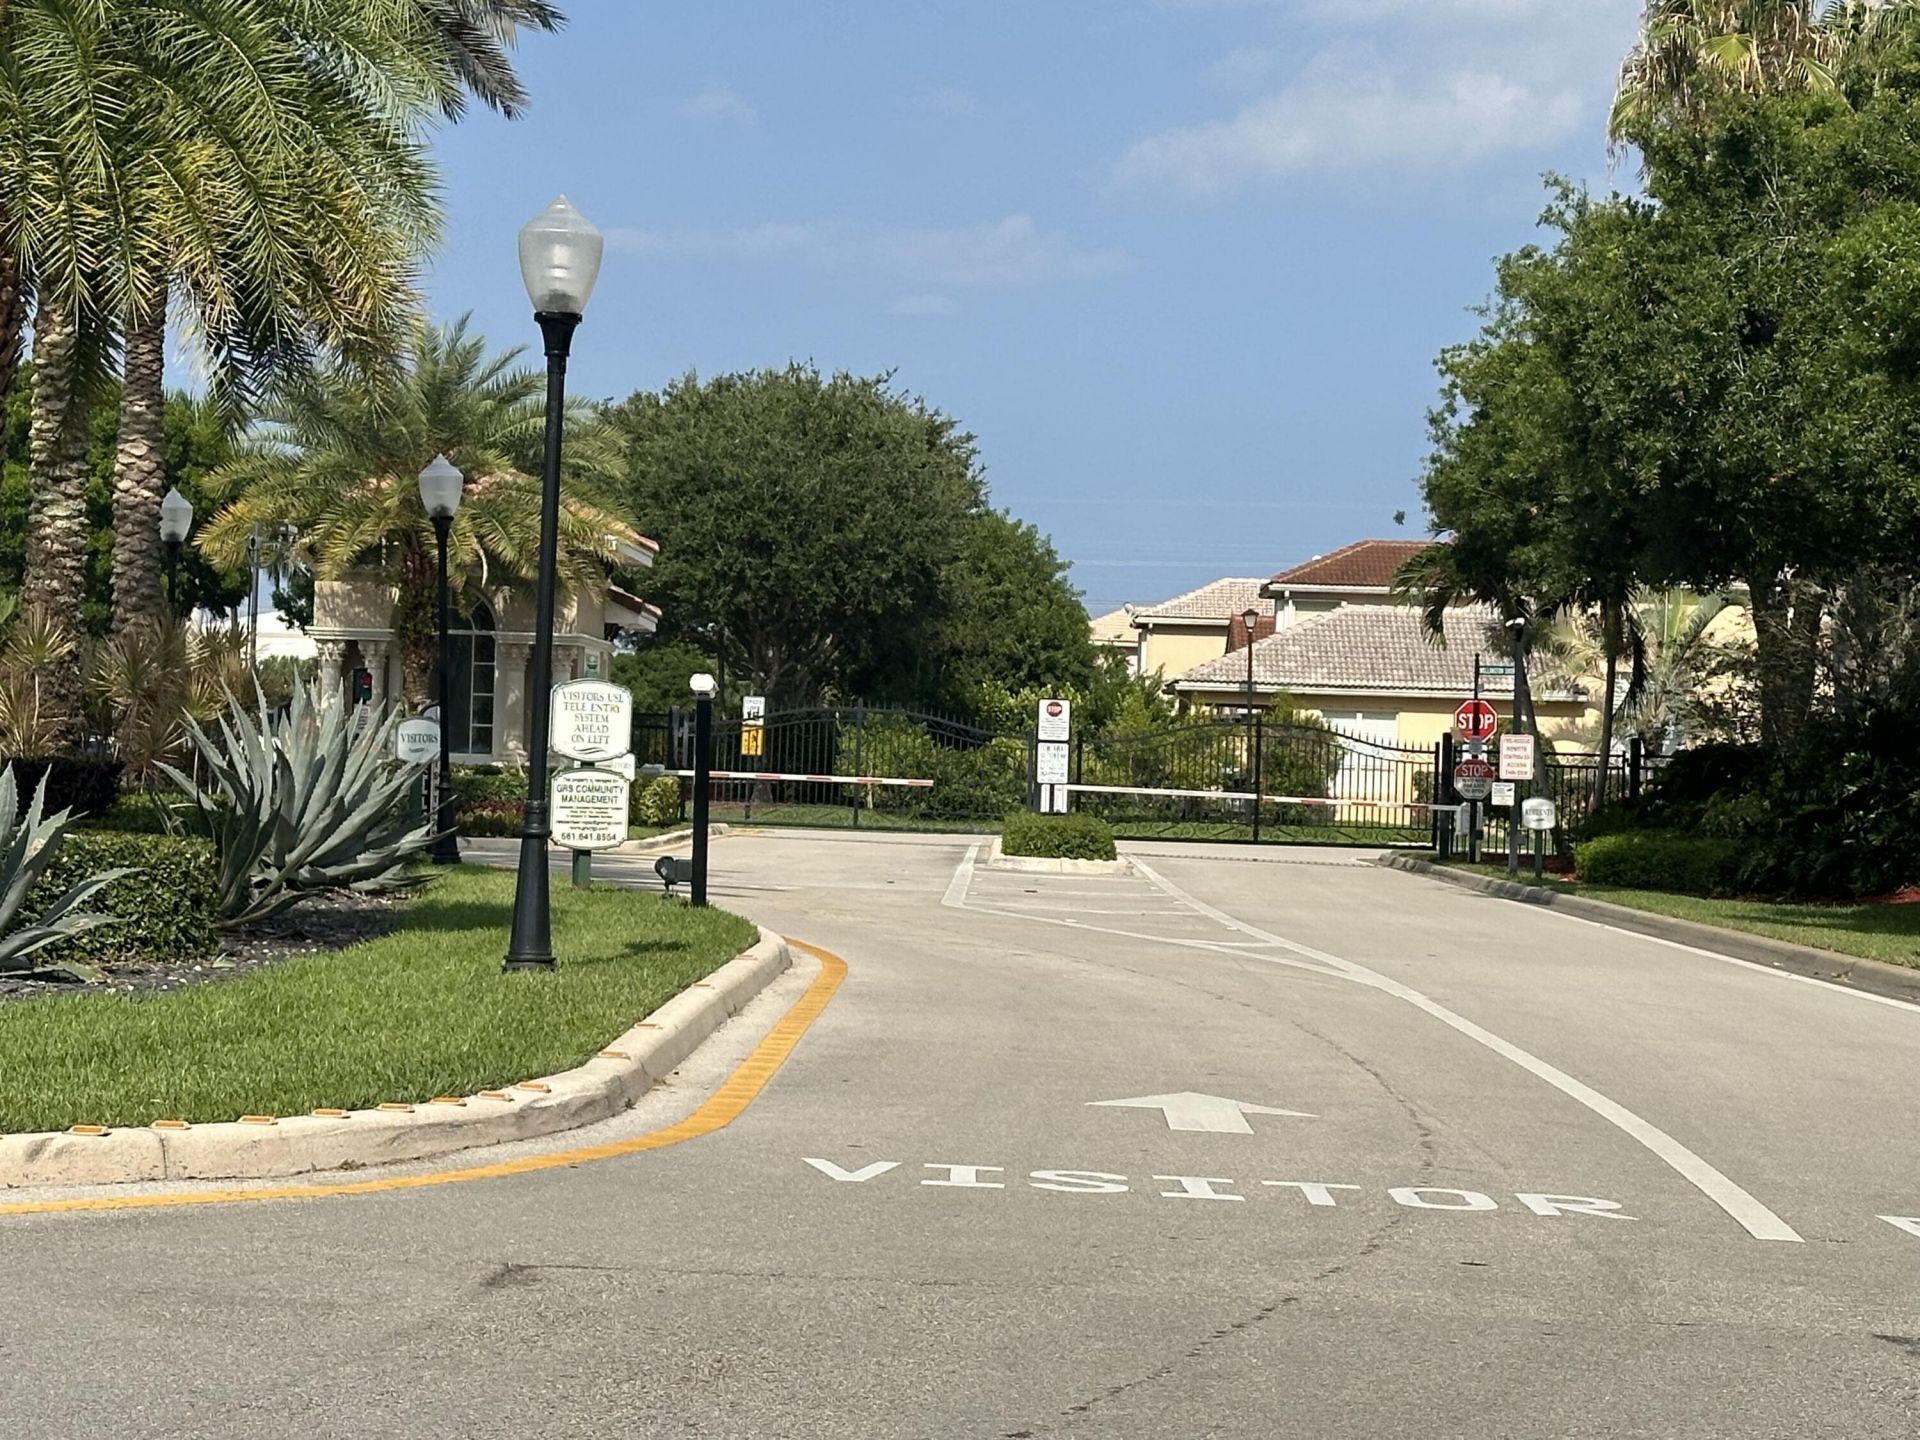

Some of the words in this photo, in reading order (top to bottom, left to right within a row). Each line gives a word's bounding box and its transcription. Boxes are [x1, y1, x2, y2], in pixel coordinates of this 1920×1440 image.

[561, 690, 604, 702] VISITORS
[607, 693, 624, 703] USE
[563, 701, 588, 712] TELE
[590, 703, 620, 714] ENTRY
[574, 713, 609, 723] SYSTEM
[573, 724, 609, 734] AHEAD
[400, 733, 439, 743] VISITORS
[571, 734, 585, 743] ON
[587, 735, 610, 745] LEFT
[1461, 764, 1489, 777] STOP
[575, 785, 624, 795] COMMUNITY
[561, 794, 619, 804] MANAGEMENT
[801, 1157, 1639, 1221] VISITOR
